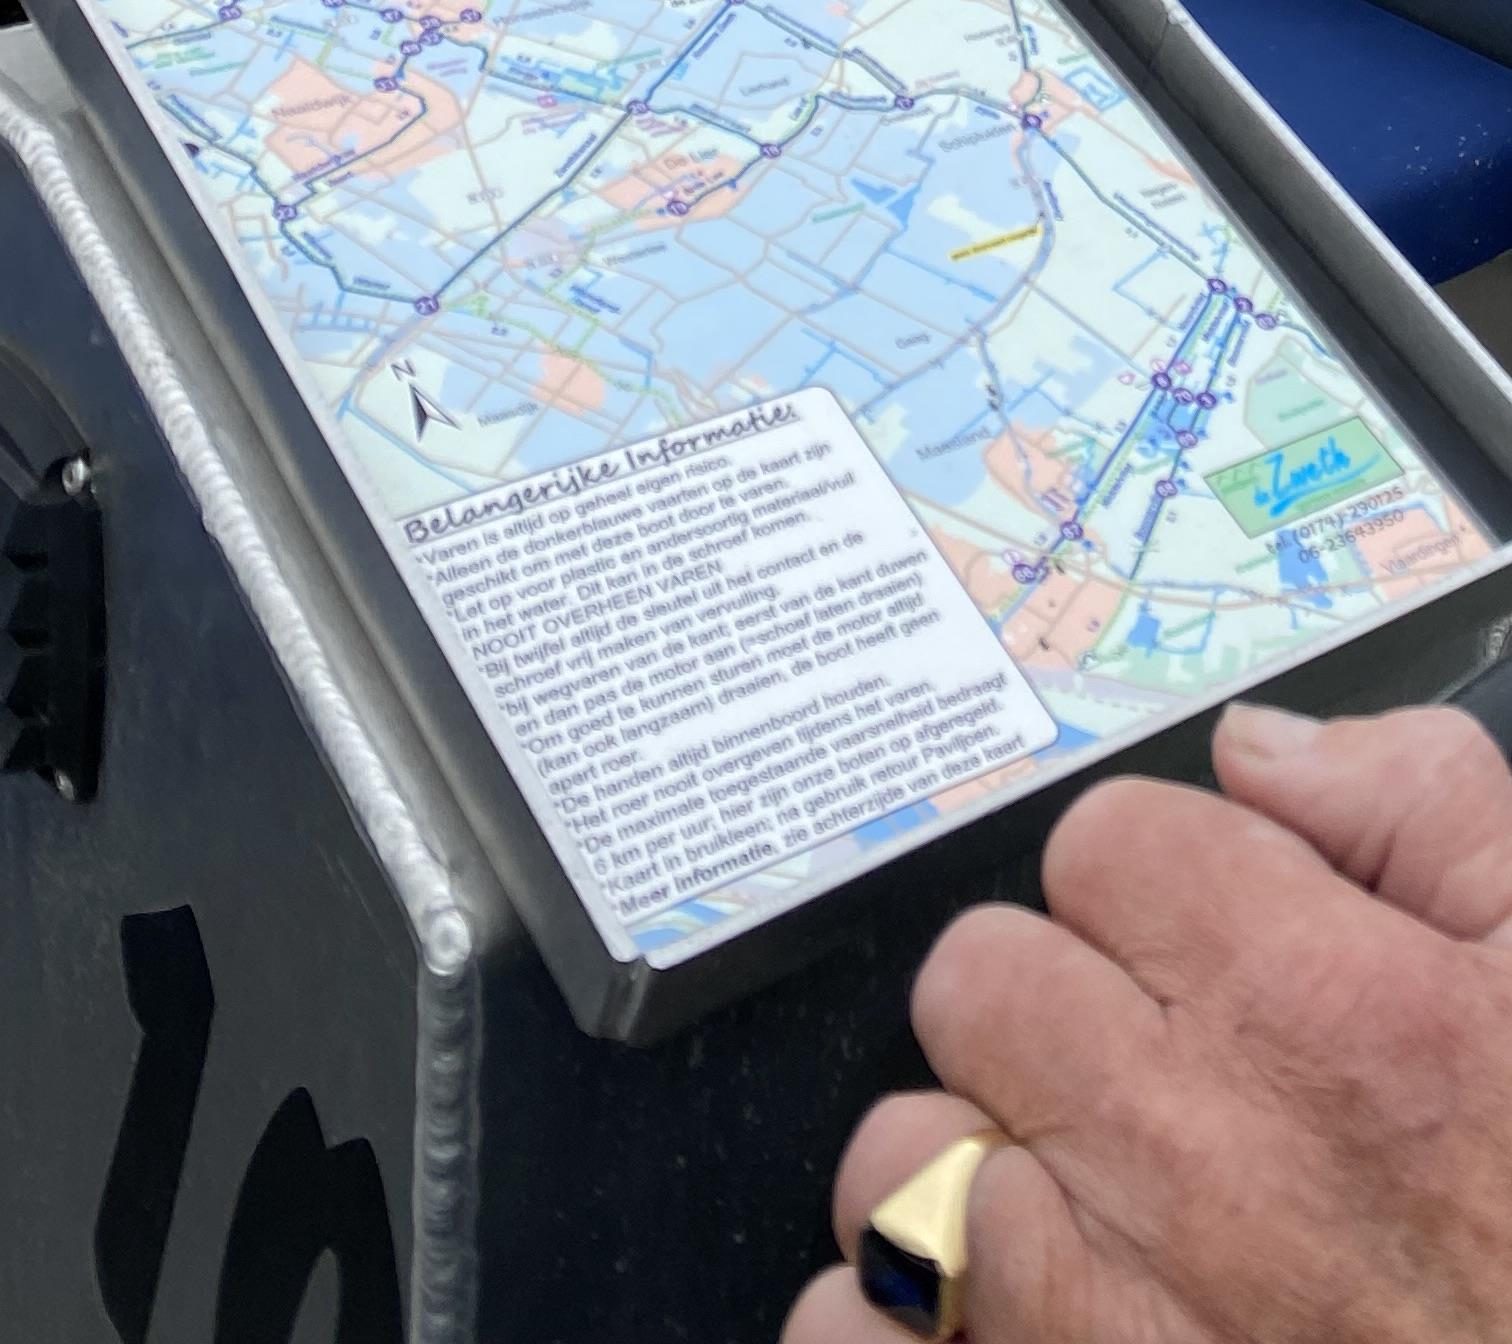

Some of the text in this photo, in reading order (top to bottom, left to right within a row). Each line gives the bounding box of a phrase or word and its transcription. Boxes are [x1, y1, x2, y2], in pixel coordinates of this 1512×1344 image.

[391, 359, 416, 381] N
[405, 403, 800, 543] Belangerijke Informatie:
[481, 530, 501, 547] is
[502, 512, 547, 540] altijd
[547, 507, 575, 525] op
[573, 483, 635, 520] geheel
[634, 470, 684, 496] eigen
[493, 545, 521, 564] de
[520, 504, 645, 555] donkerblauwe
[644, 482, 711, 513] vaarten
[710, 474, 737, 491] op
[733, 466, 760, 483] de
[758, 448, 803, 475] kaart
[802, 441, 833, 461] zijn
[440, 563, 520, 607] geschikt
[519, 555, 554, 577] om
[552, 540, 590, 566] met
[588, 527, 636, 553] deze
[635, 510, 677, 537] boot
[675, 500, 717, 523] door
[716, 493, 738, 509] te
[457, 623, 482, 642] in
[481, 608, 516, 634] het
[575, 578, 604, 601] Dit
[604, 569, 641, 591] kan
[639, 562, 661, 578] in
[659, 553, 687, 572] de
[686, 527, 751, 563] schroef
[486, 589, 517, 609] op
[514, 575, 558, 600] voor
[559, 554, 618, 588] plastic
[618, 545, 645, 564] en
[644, 509, 753, 555] andersoortig
[1298, 509, 1404, 563] 06-23643950
[1380, 535, 1460, 574] Vlaardingen
[470, 555, 725, 659] NOOIT OVERHEEN VAREN
[493, 657, 565, 698] schroef
[564, 646, 597, 672] vrij
[595, 627, 660, 660] maken
[658, 614, 695, 637] van
[511, 635, 569, 669] twijfel
[569, 618, 614, 649] altijd
[613, 612, 641, 632] de
[641, 587, 701, 622] sleutel
[701, 578, 726, 601] uit
[724, 568, 756, 592] het
[755, 545, 818, 581] contact
[817, 540, 843, 558] en
[839, 532, 866, 550] de
[513, 714, 542, 736] en
[541, 700, 582, 725] dan
[581, 686, 620, 714] pas
[617, 675, 647, 696] de
[646, 655, 701, 686] motor
[701, 641, 738, 665] aan
[811, 597, 858, 623] laten
[854, 569, 925, 607] draaien)
[531, 662, 624, 707] wegvaren
[623, 648, 661, 672] van
[659, 639, 687, 659] de
[732, 601, 780, 632] eerst
[778, 592, 813, 615] van
[811, 583, 838, 602] de
[835, 566, 876, 593] kant
[873, 549, 930, 579] duwen
[532, 745, 582, 777] (kan
[580, 727, 619, 757] ook
[618, 690, 717, 742] langzaam)
[787, 656, 815, 676] de
[813, 637, 855, 666] boot
[852, 621, 899, 651] heeft
[897, 607, 942, 637] geen
[565, 706, 616, 744] goed
[615, 702, 638, 721] te
[637, 676, 708, 712] kunnen
[707, 654, 765, 686] sturen
[764, 633, 811, 664] moet
[808, 627, 836, 647] de
[835, 609, 885, 637] motor
[885, 590, 926, 618] altijd
[546, 759, 599, 794] apart
[591, 761, 666, 801] handen
[666, 739, 712, 772] altijd
[710, 696, 823, 754] binnenboord
[609, 845, 643, 870] km
[643, 830, 678, 860] per
[717, 798, 757, 825] hier
[757, 784, 792, 809] zijn
[790, 765, 838, 795] onze
[835, 744, 890, 776] boten
[887, 734, 915, 755] op
[610, 791, 651, 819] roer
[652, 768, 700, 802] nooit
[699, 733, 796, 783] overgeven
[793, 710, 855, 744] tijdens
[852, 694, 885, 720] het
[615, 792, 708, 841] maximale
[706, 743, 830, 803] toegestaande
[828, 696, 936, 754] vaarsnelheid
[933, 667, 1009, 710] bedraagt
[780, 823, 811, 847] zie
[810, 783, 907, 834] achterzijde
[905, 768, 941, 794] van
[937, 751, 983, 779] deze
[980, 729, 1026, 761] kaart
[660, 851, 684, 871] in
[774, 802, 802, 824] na
[801, 770, 869, 817] gebruik
[868, 753, 921, 785] retour
